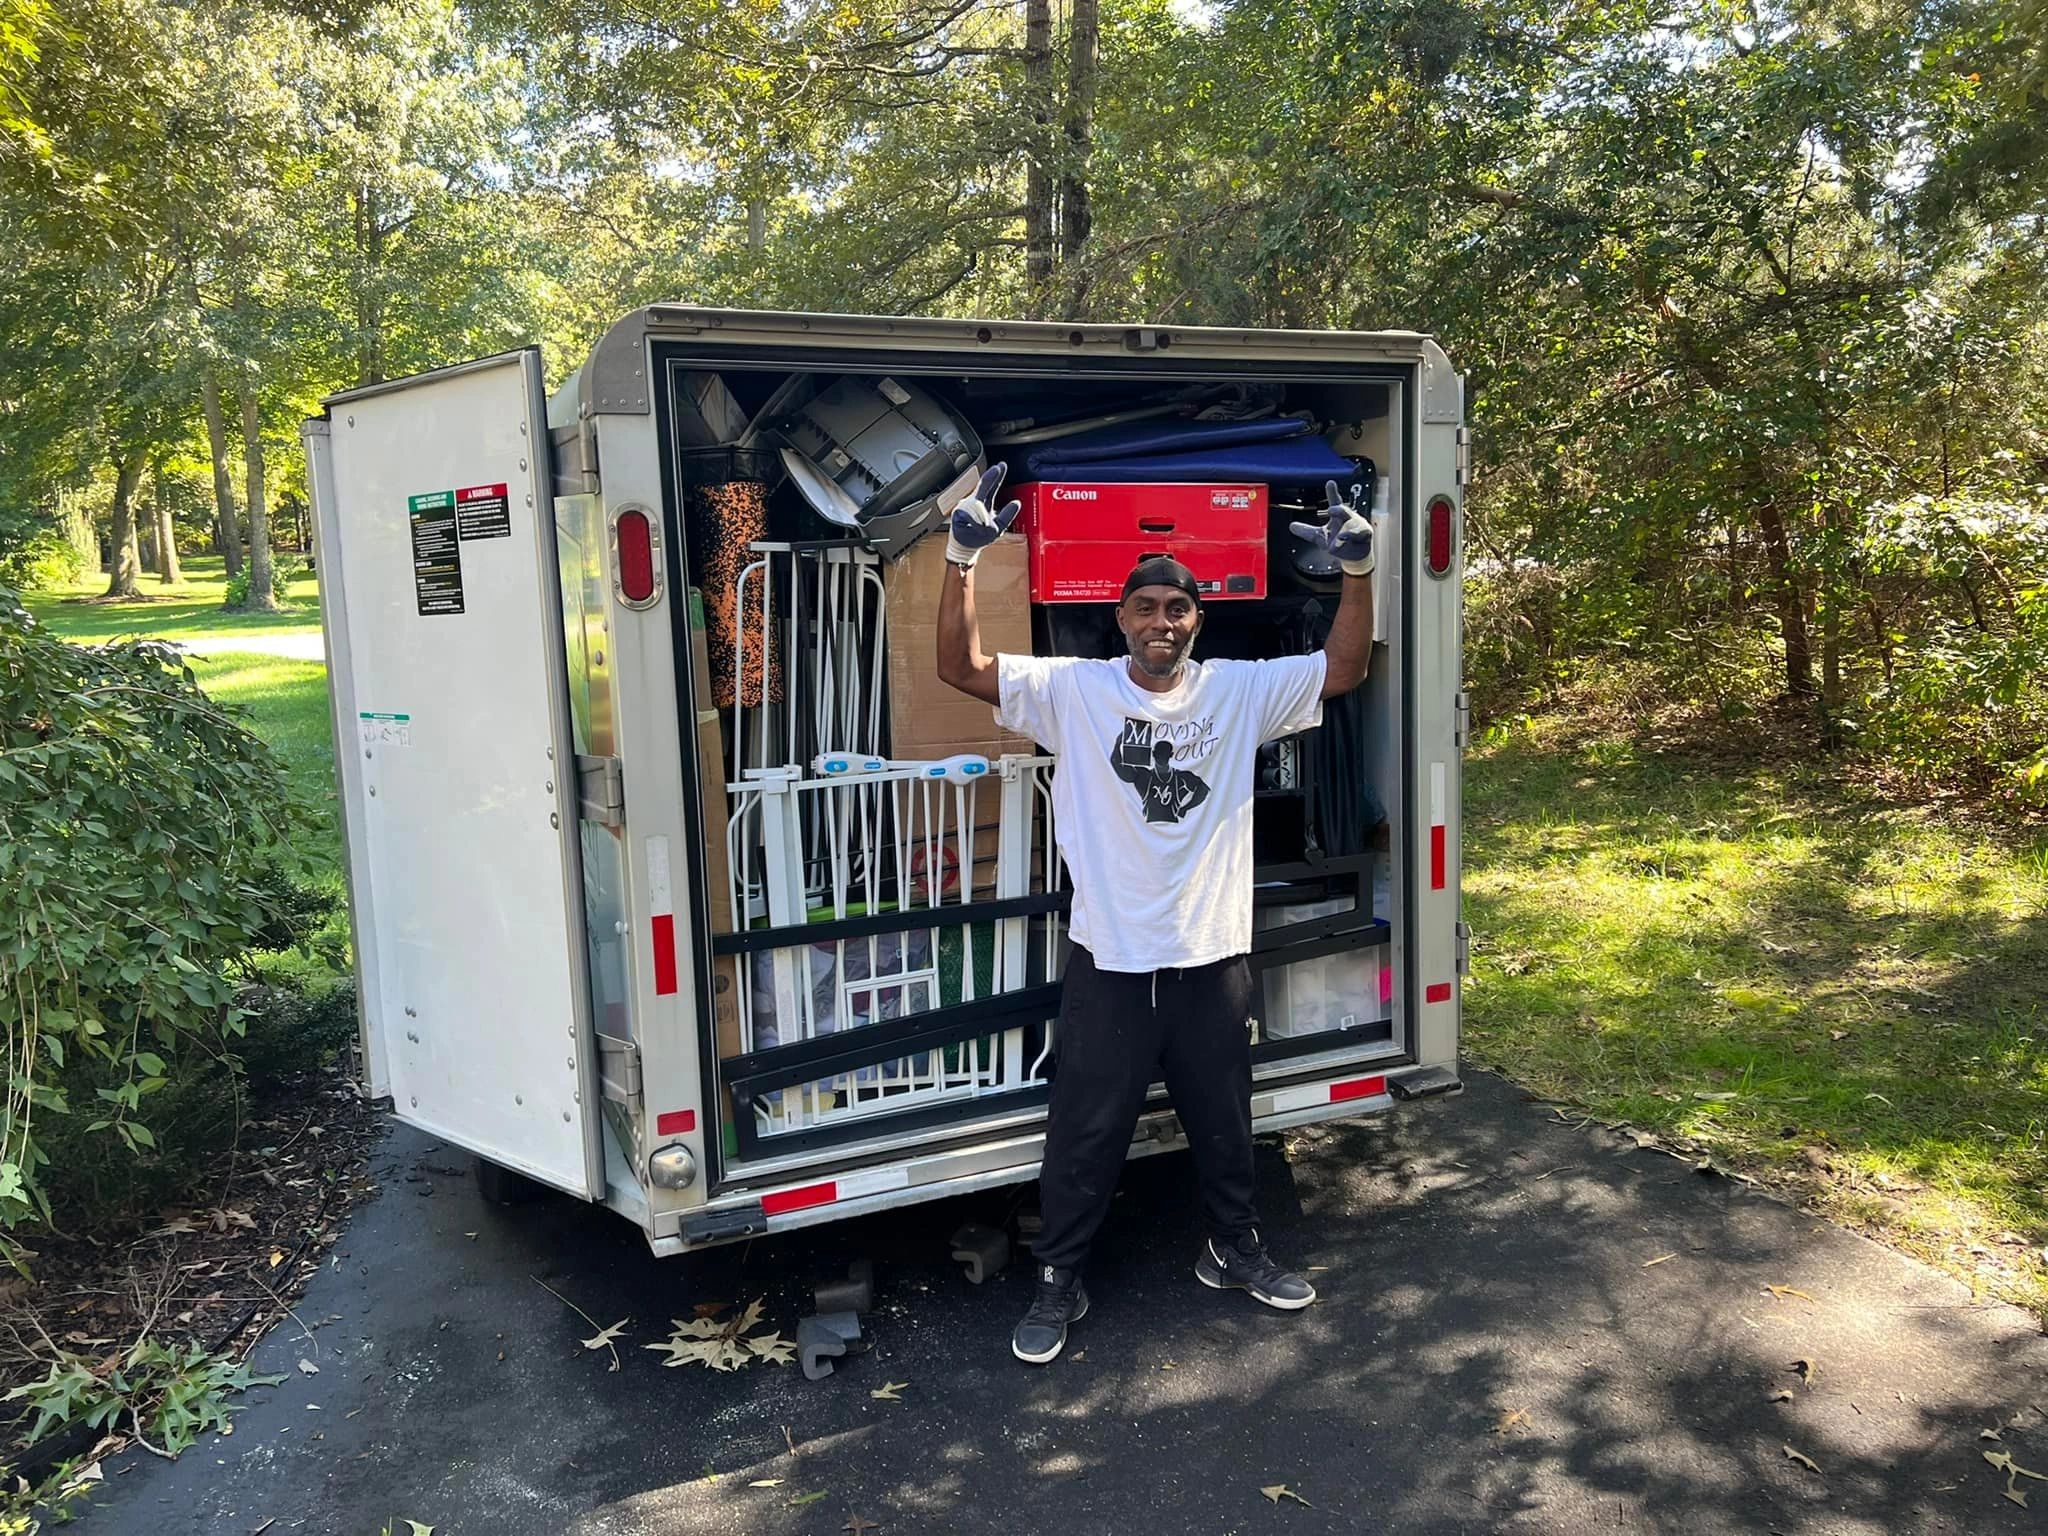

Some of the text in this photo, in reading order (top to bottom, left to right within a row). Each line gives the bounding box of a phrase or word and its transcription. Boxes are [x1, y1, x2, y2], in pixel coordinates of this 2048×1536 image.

[1052, 488, 1097, 501] Canon
[1126, 716, 1214, 745] MOVING
[1174, 736, 1219, 762] OUT
